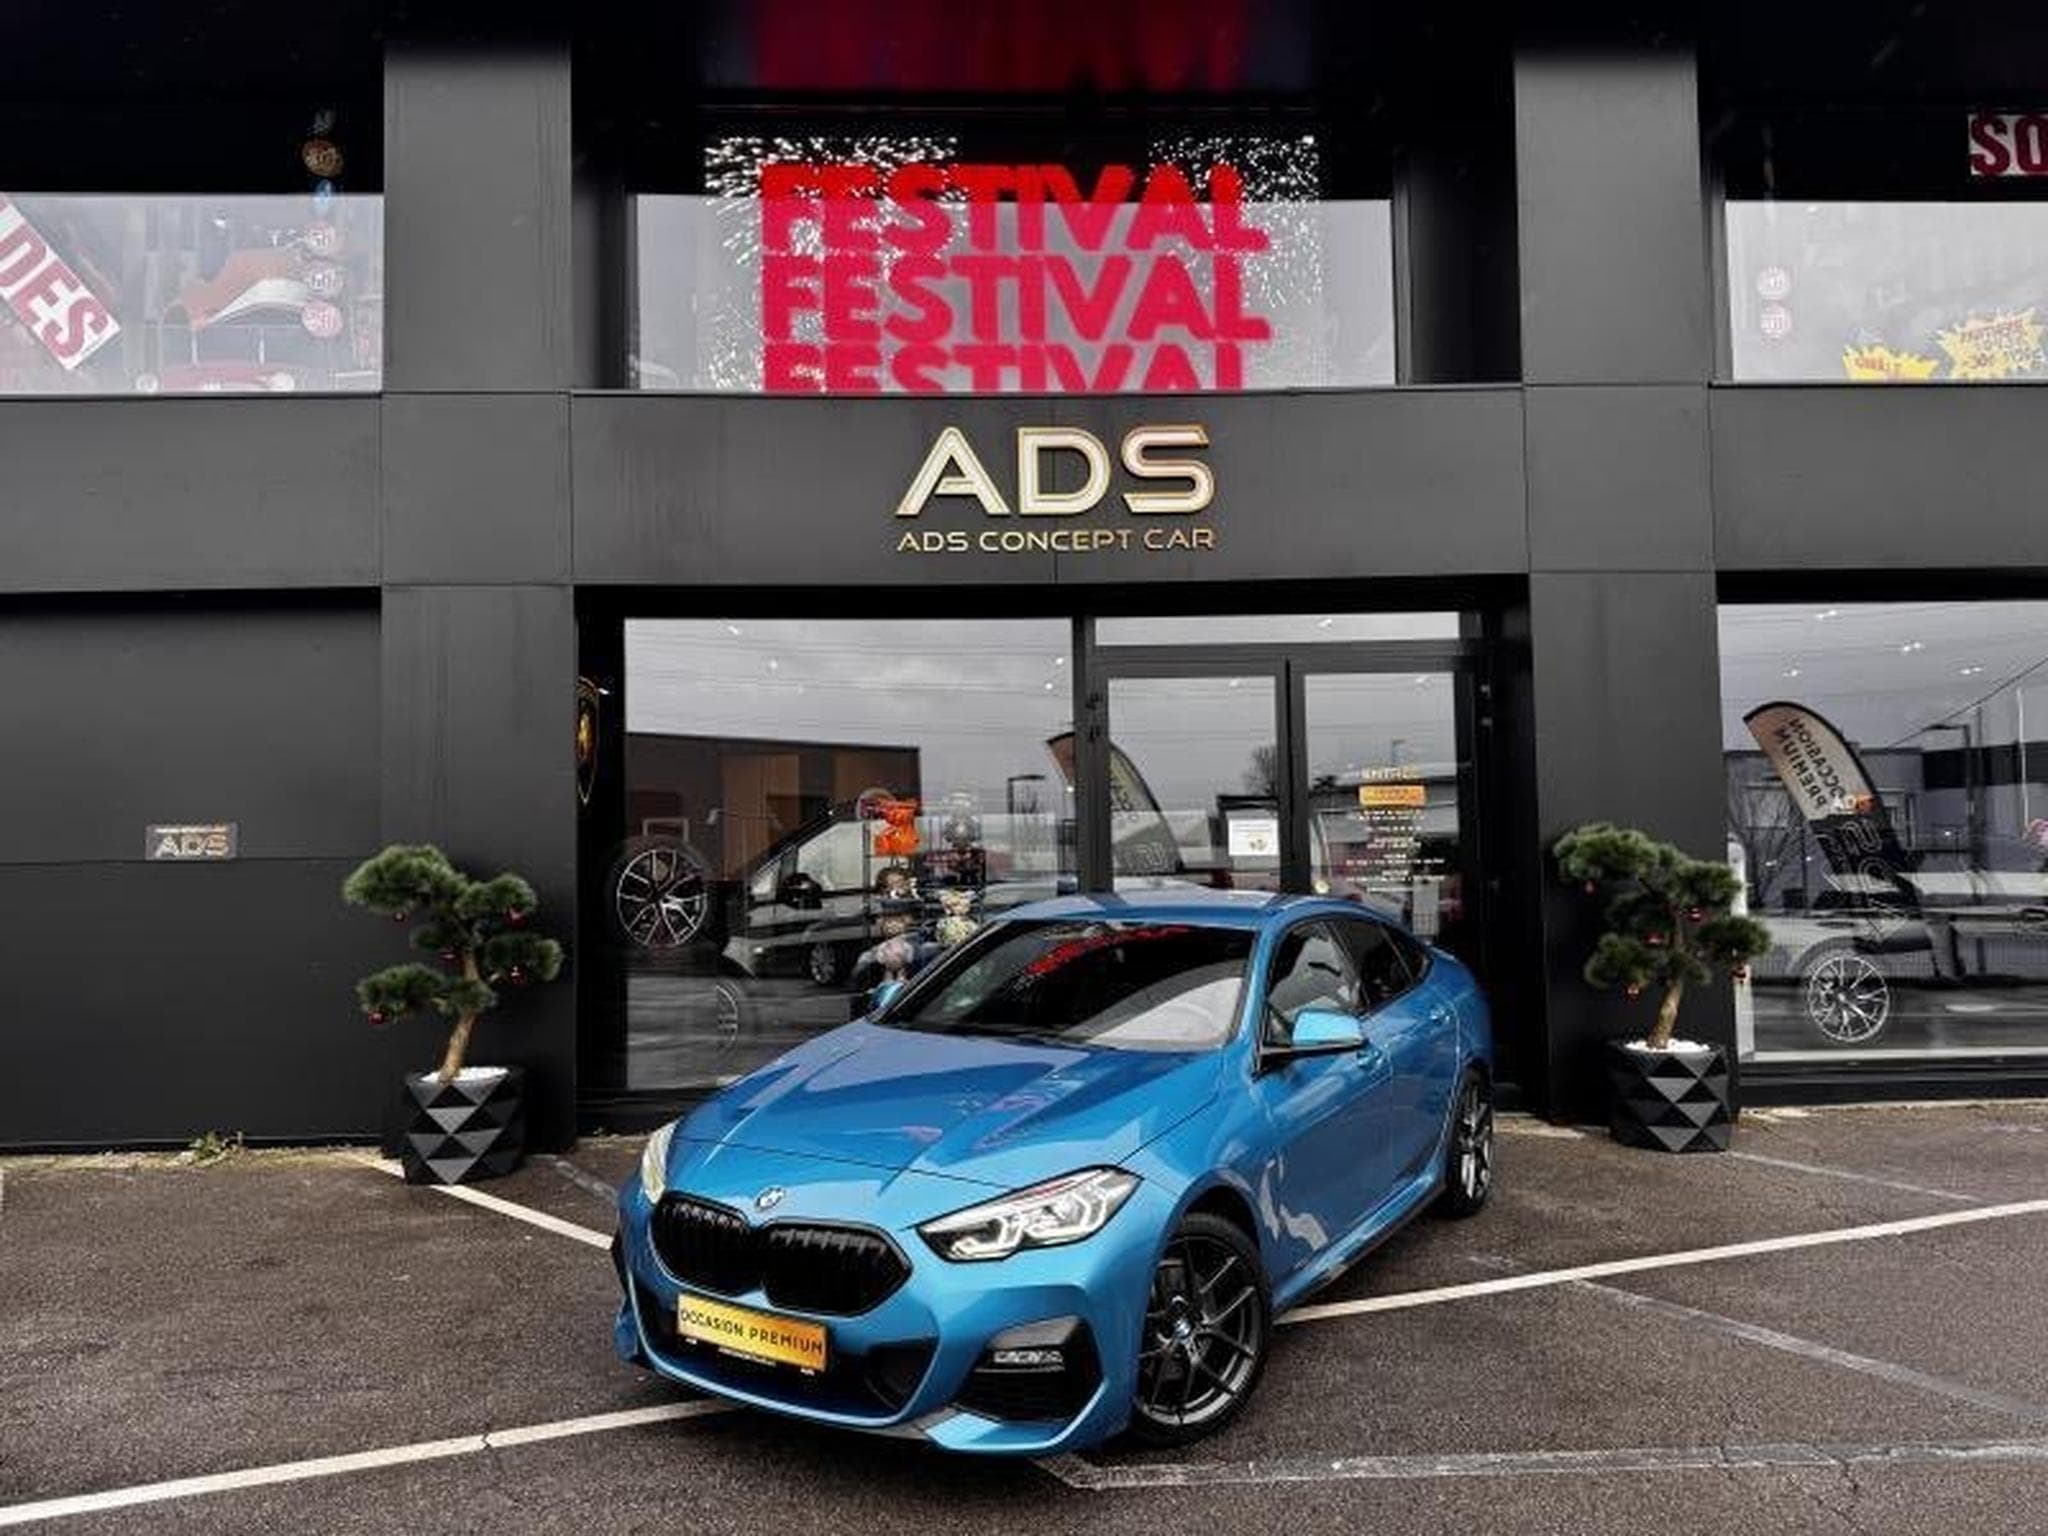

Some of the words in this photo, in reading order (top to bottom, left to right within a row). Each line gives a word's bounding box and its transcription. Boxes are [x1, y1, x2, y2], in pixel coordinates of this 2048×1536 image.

[762, 164, 1270, 252] FESTIVAL
[0, 196, 109, 358] DES
[762, 254, 1272, 342] FESTIVAL
[895, 426, 1216, 516] ADS
[896, 531, 967, 552] ADS
[979, 529, 1132, 552] CONCEPT
[1143, 528, 1216, 549] CAR
[680, 1308, 744, 1338] OCCASION
[749, 1327, 823, 1355] PREMIUM
